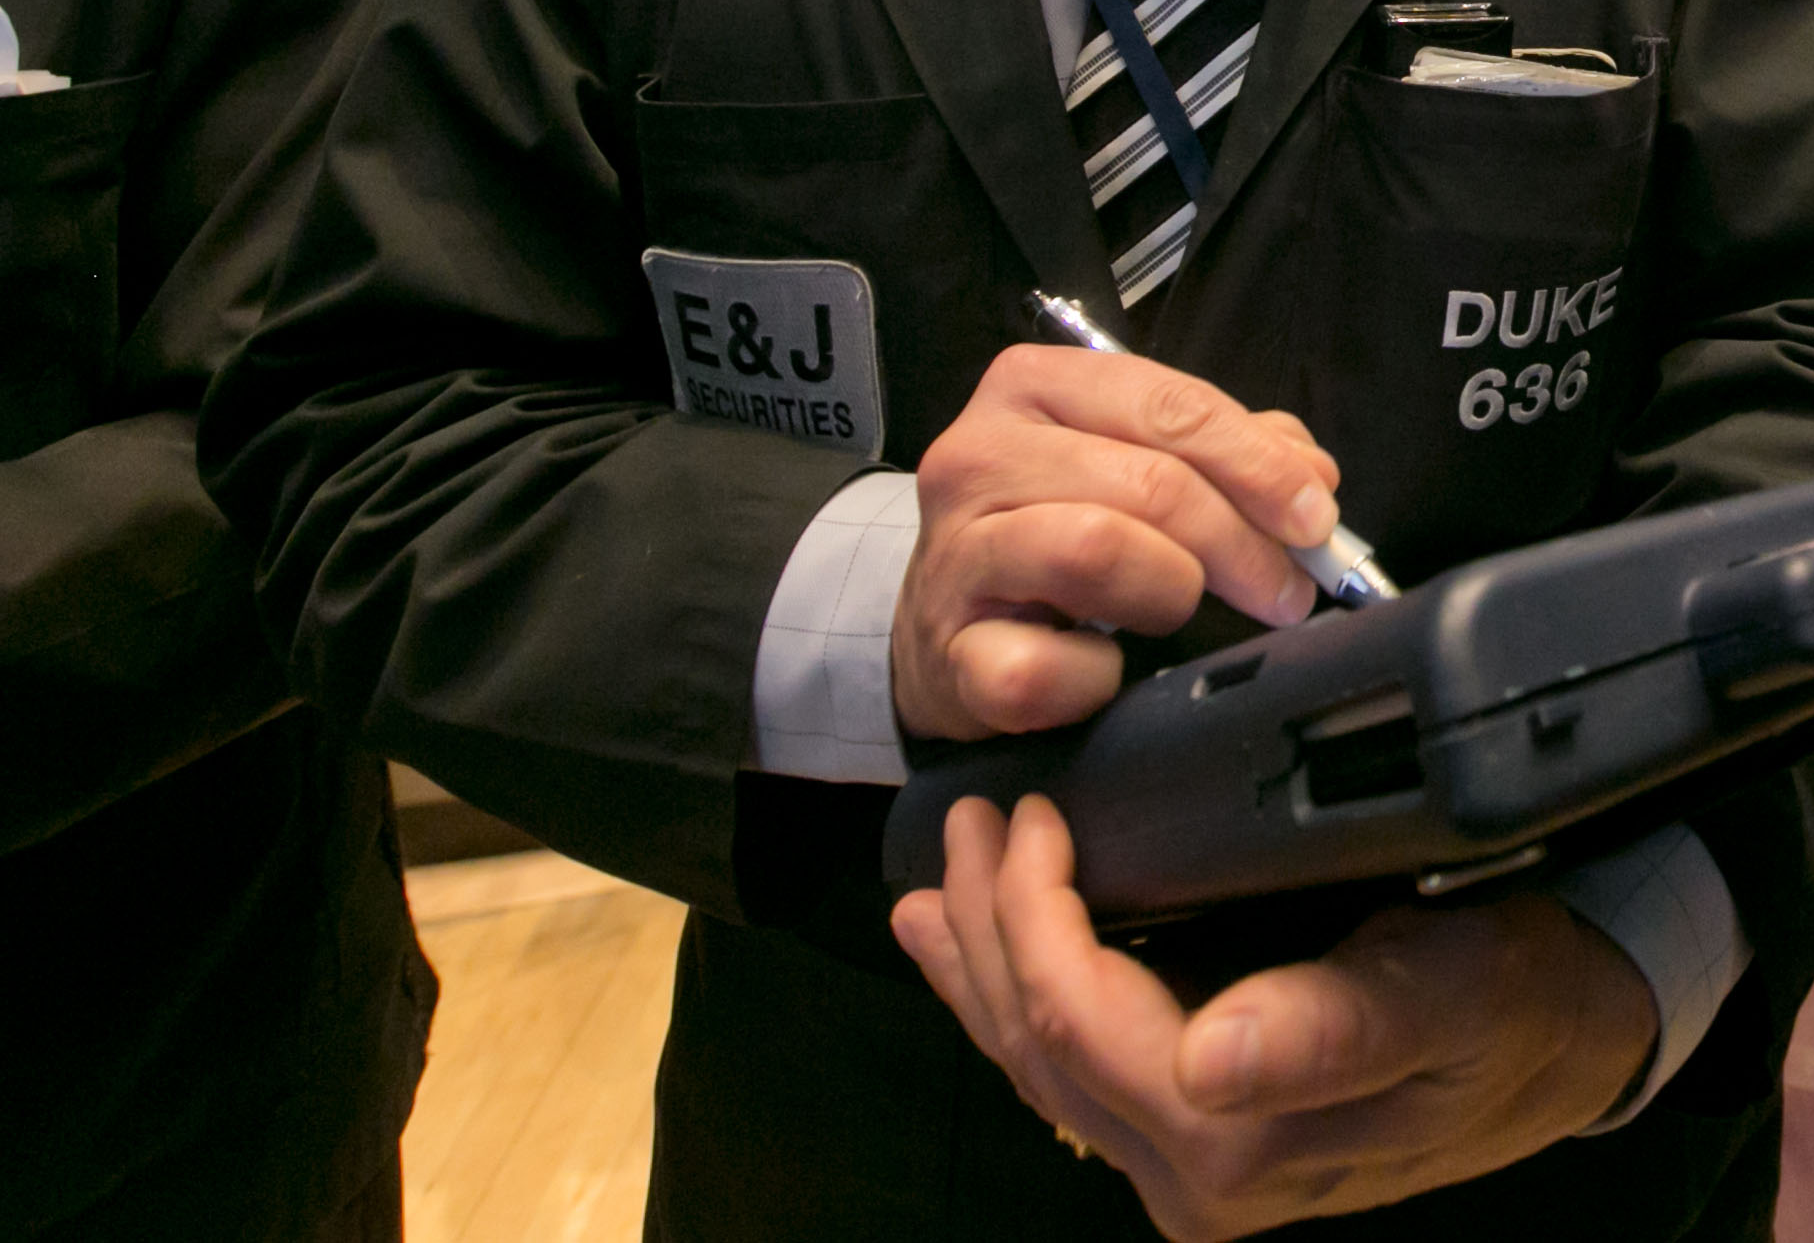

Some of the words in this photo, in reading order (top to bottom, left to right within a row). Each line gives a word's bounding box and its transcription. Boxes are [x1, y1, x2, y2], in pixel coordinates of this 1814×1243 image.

[1441, 265, 1624, 349] DUKE
[686, 377, 856, 439] SECURITIES
[1458, 350, 1592, 431] 636
